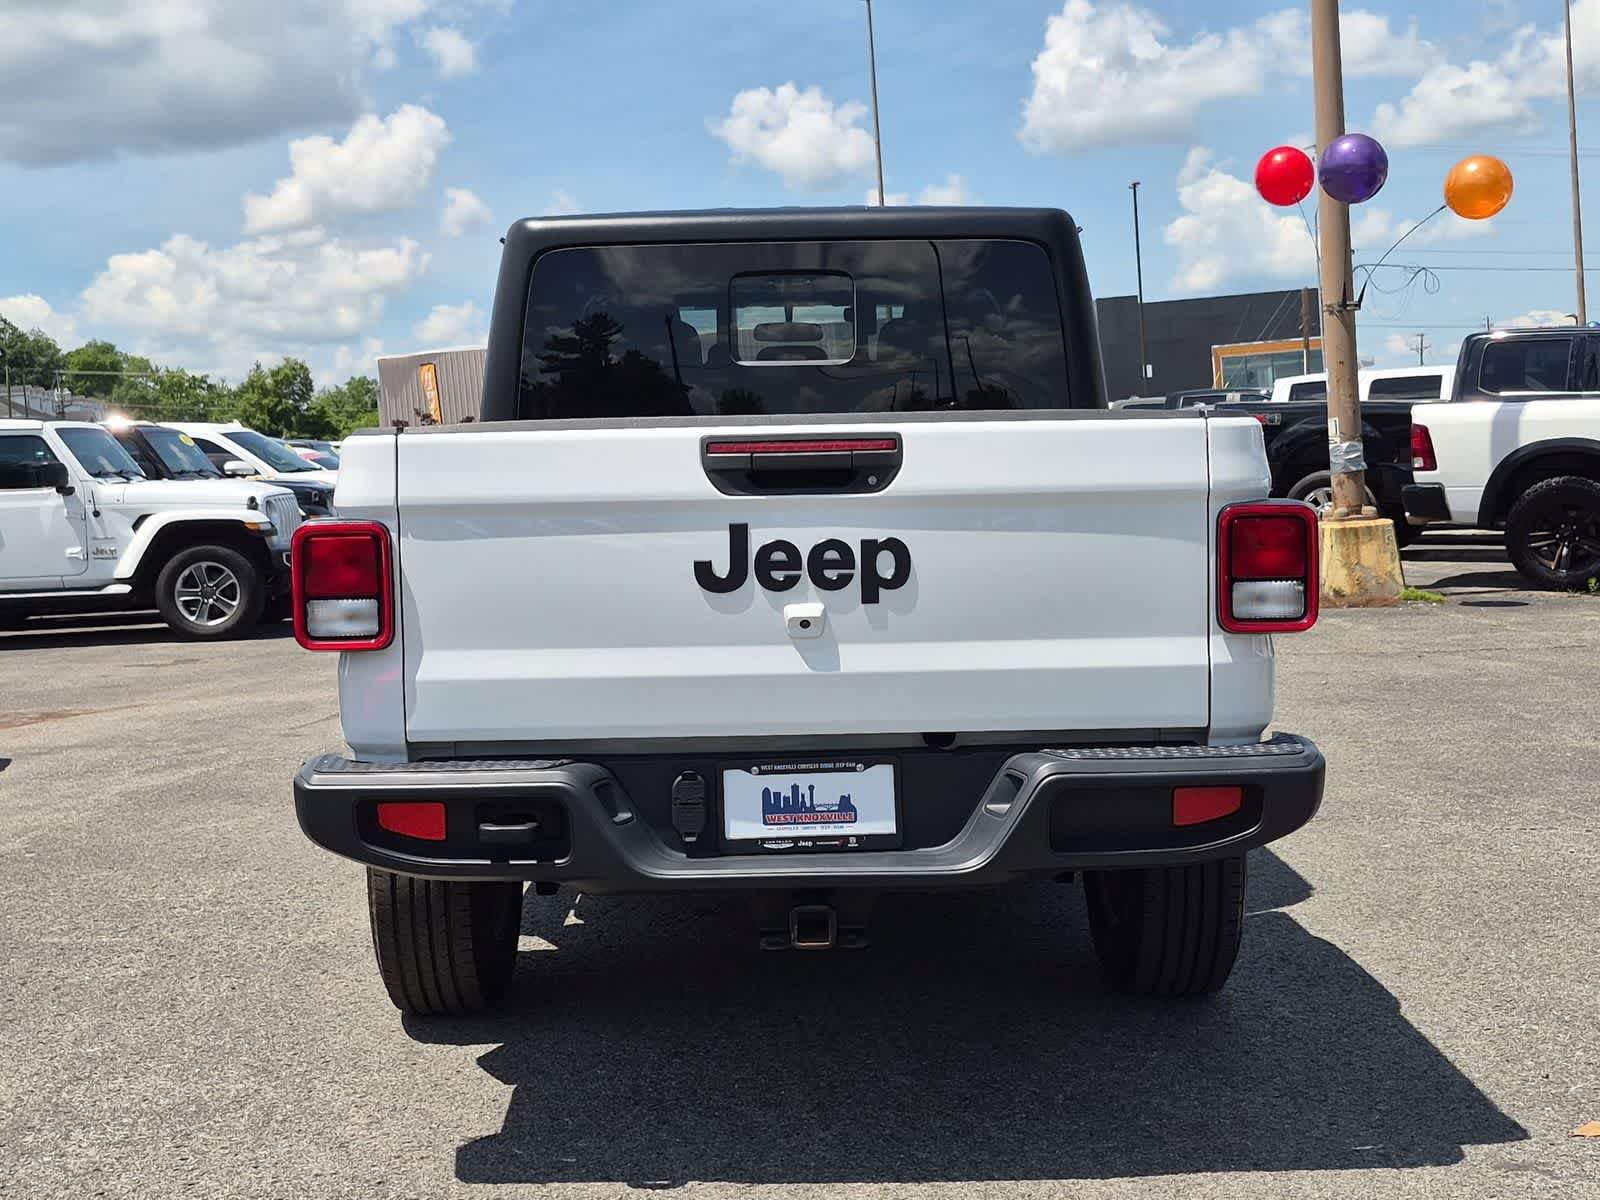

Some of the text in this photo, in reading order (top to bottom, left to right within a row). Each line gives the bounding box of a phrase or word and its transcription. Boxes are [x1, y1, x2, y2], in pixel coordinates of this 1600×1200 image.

[694, 522, 911, 604] Jeep
[766, 812, 854, 824] WEST KNOXVILLE
